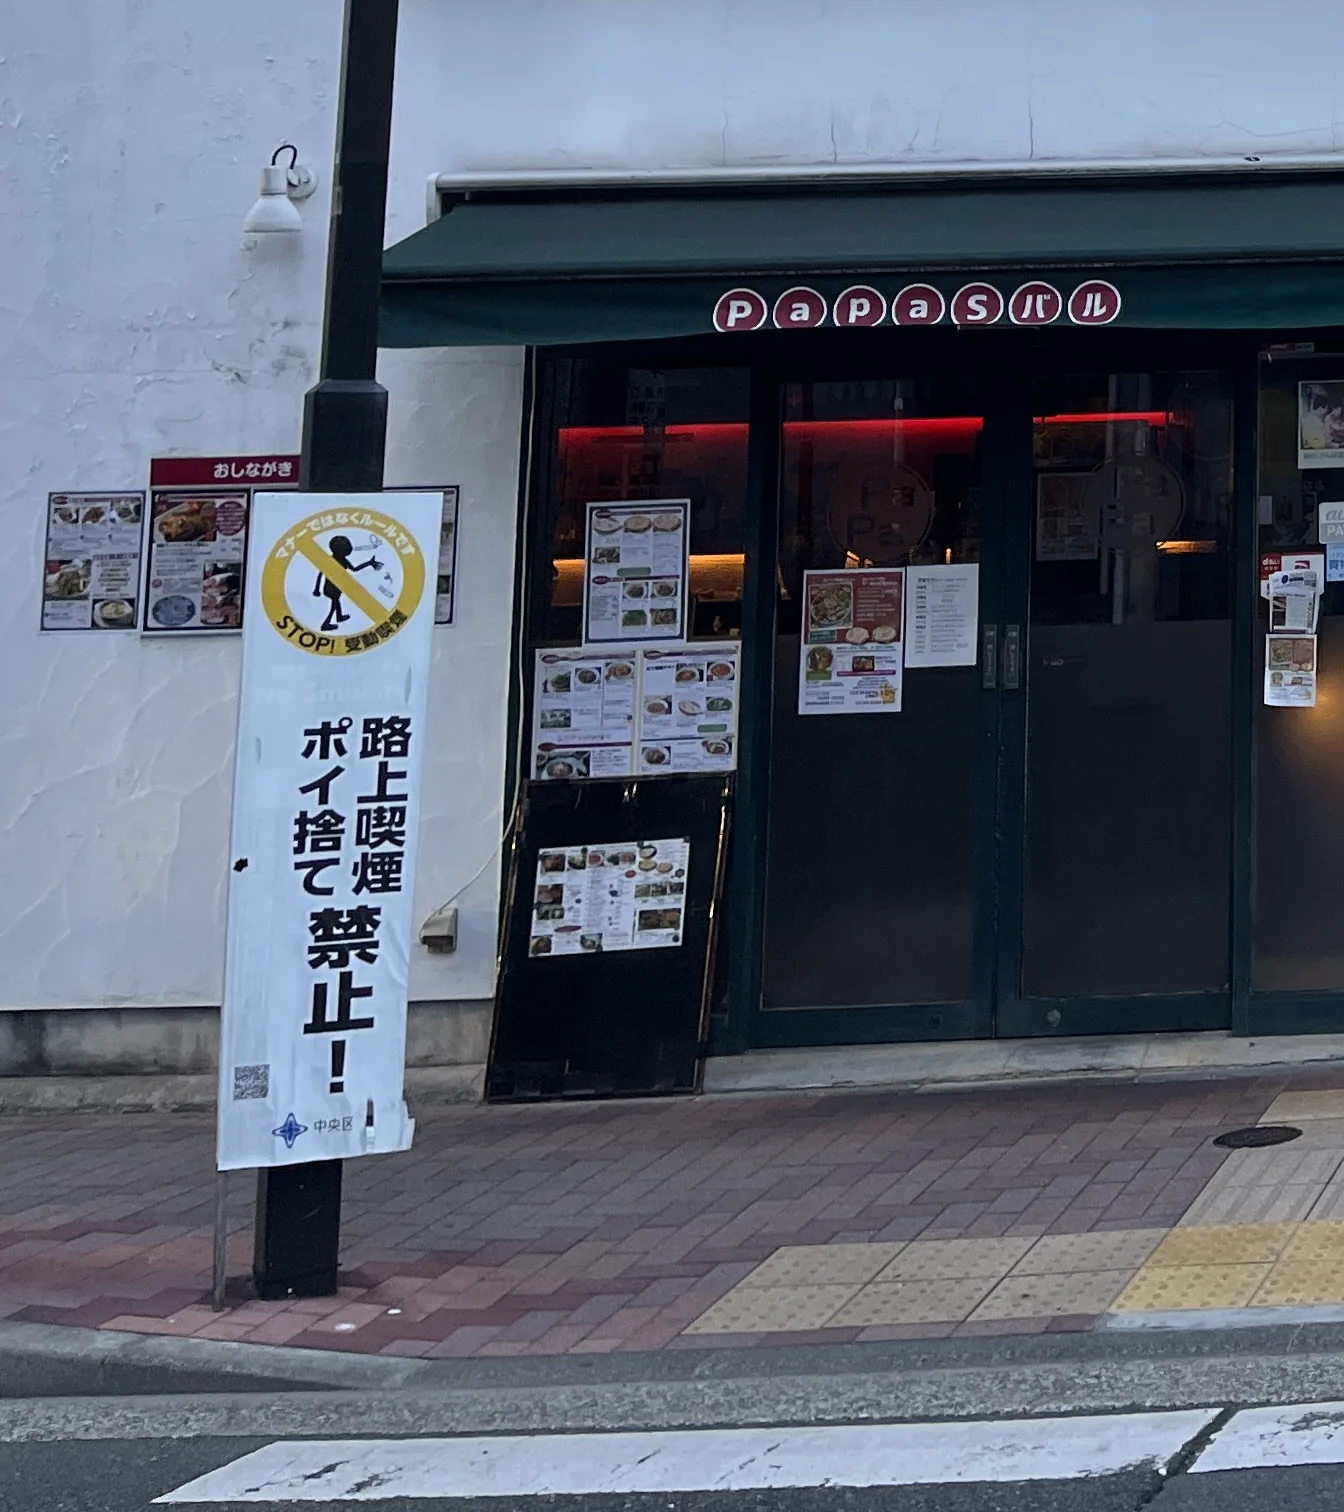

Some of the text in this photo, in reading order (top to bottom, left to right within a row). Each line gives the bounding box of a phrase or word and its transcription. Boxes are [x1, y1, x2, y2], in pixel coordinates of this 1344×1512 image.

[213, 461, 293, 479] おしながき
[274, 511, 416, 559] マナーではなくルールです
[275, 615, 336, 655] STOP!
[344, 608, 409, 654] 受動喫煙
[292, 716, 354, 896] ポイ捨て
[351, 714, 414, 896] 路上喫煙
[302, 903, 383, 1095] 禁止！
[313, 1114, 354, 1133] 中央区
